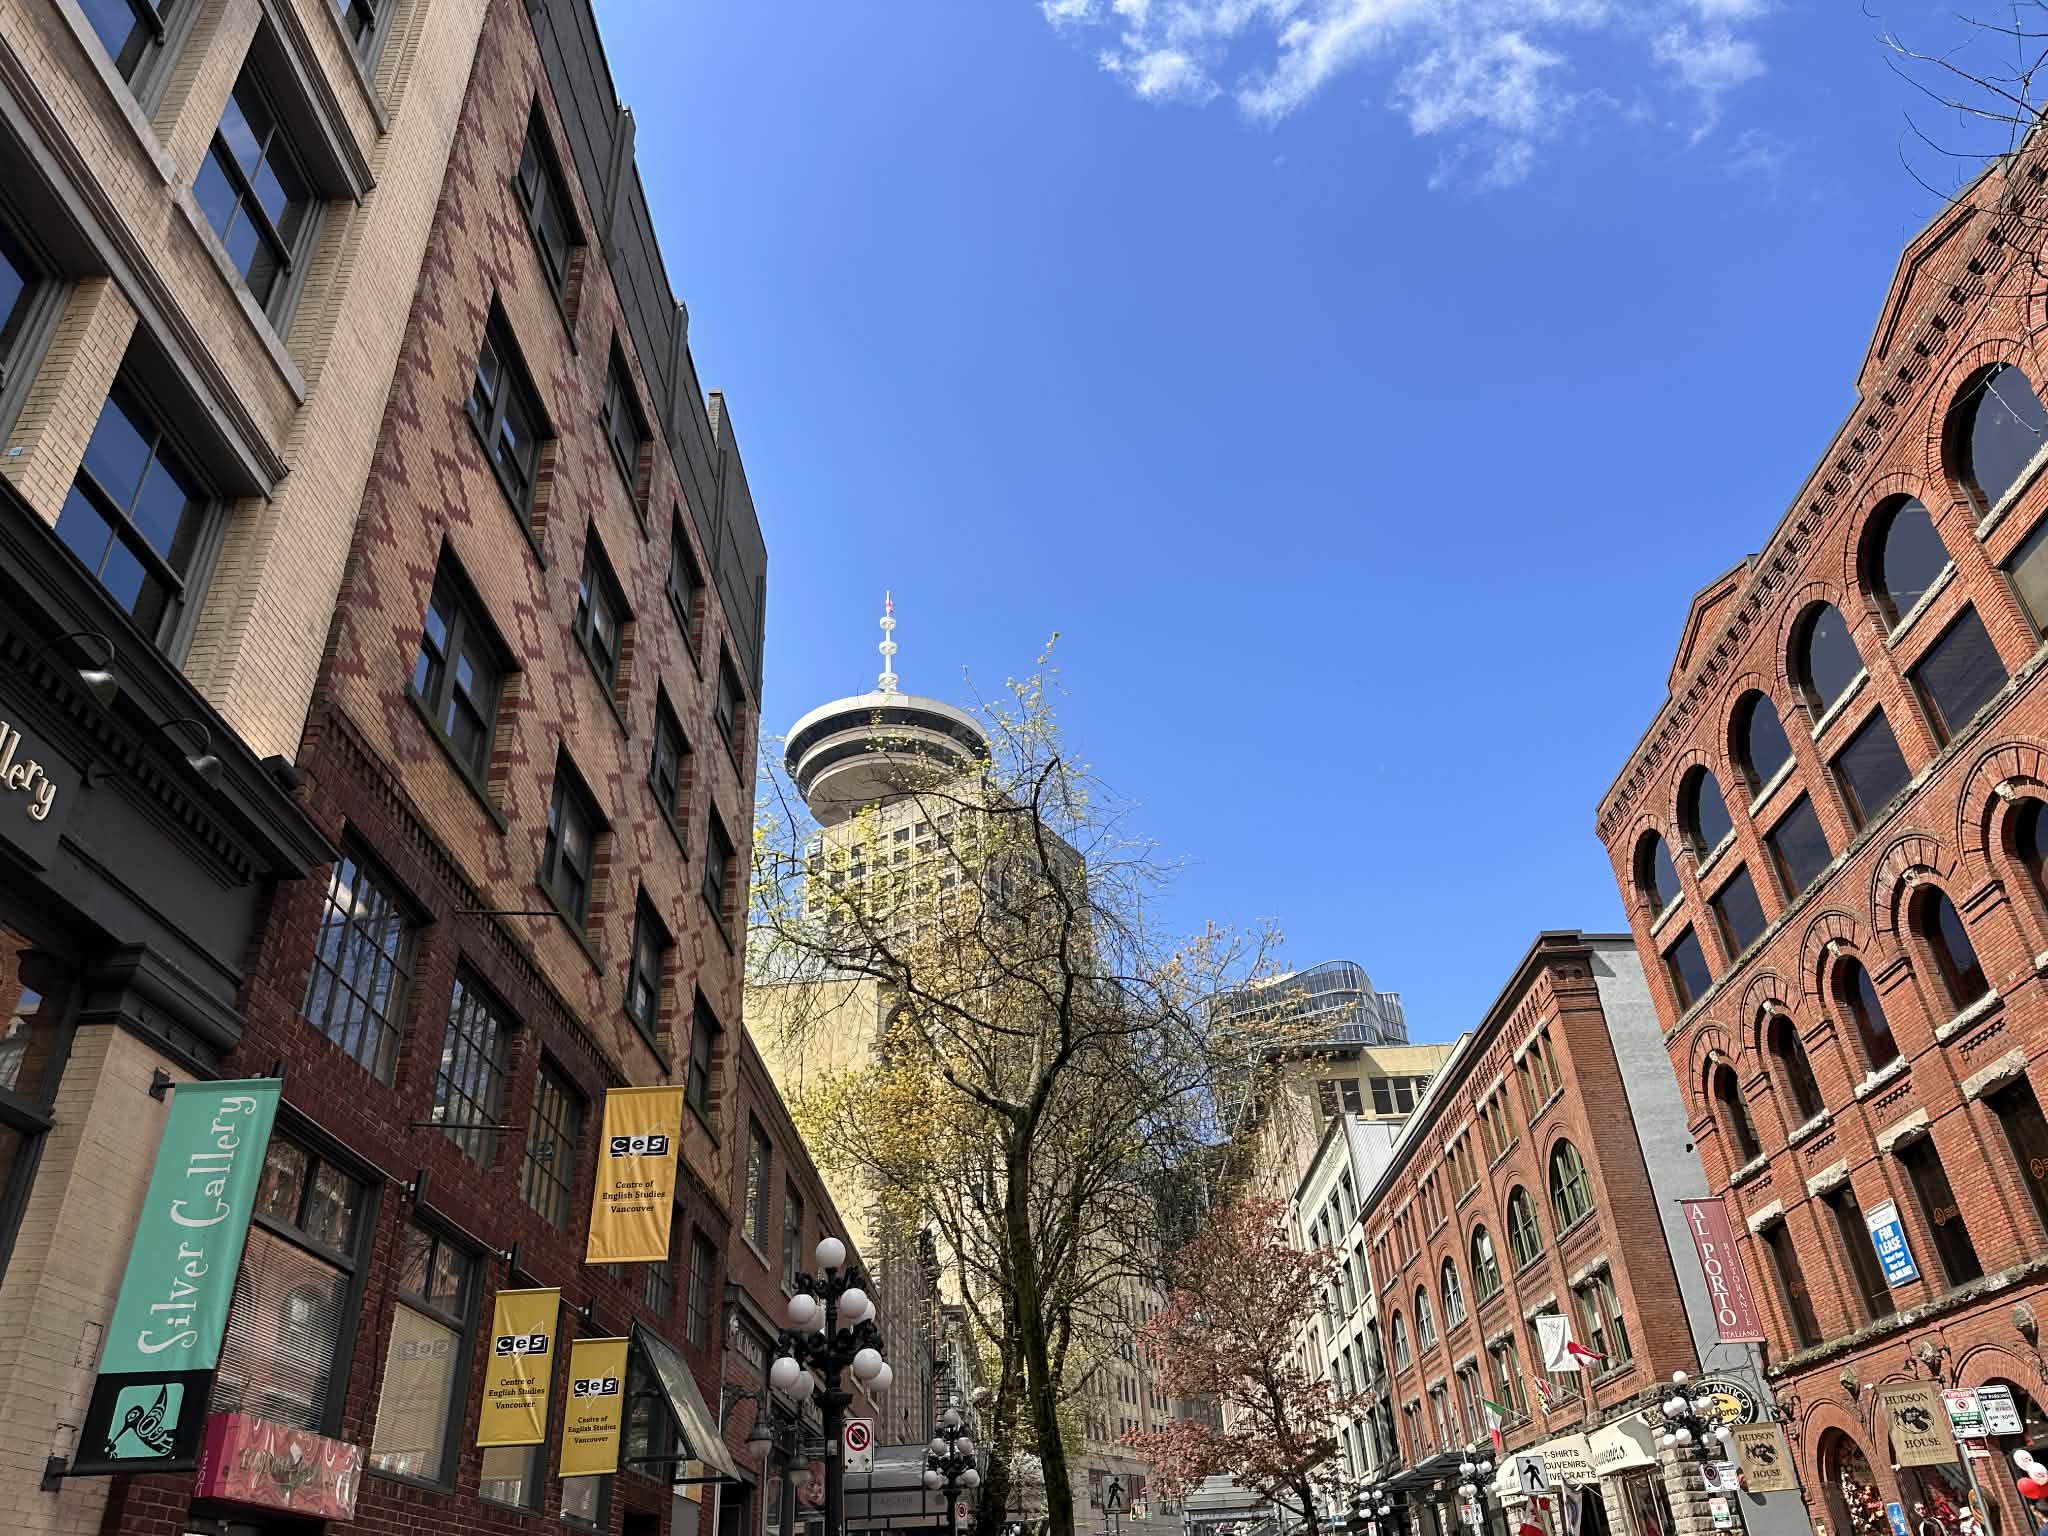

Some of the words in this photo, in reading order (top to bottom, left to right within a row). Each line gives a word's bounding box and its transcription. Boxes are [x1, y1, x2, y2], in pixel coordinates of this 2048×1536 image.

[0, 720, 57, 821] llery
[615, 1181, 643, 1189] Centre
[645, 1180, 654, 1188] of
[602, 1192, 633, 1202] English
[635, 1190, 666, 1199] Studies
[610, 1205, 655, 1213] Vancouver
[1879, 1235, 1903, 1257] LEASE
[1692, 1203, 1710, 1236] AL
[1701, 1242, 1737, 1327] PORTO
[1723, 1242, 1753, 1326] RISTORANTE
[137, 1241, 209, 1354] Silver
[1721, 1329, 1759, 1338] ITALIANO
[500, 1378, 525, 1386] Centre
[526, 1377, 535, 1385] of
[488, 1389, 516, 1398] English
[517, 1387, 545, 1396] Studies
[1711, 1384, 1750, 1409] ANTICO
[1883, 1391, 1930, 1406] HUDSON
[495, 1401, 536, 1410] Vancouver
[577, 1416, 600, 1424] Centre
[601, 1415, 608, 1423] of
[567, 1425, 592, 1434] English
[593, 1424, 617, 1432] Studies
[574, 1435, 609, 1444] Vancouver
[1737, 1431, 1775, 1442] HUDSON
[1904, 1438, 1942, 1449] HOUSE
[1543, 1449, 1579, 1459] T-SHIRTS
[1544, 1459, 1587, 1471] OUVENIRS
[1563, 1469, 1597, 1480] CRAFTS
[1752, 1468, 1782, 1480] HOUSE
